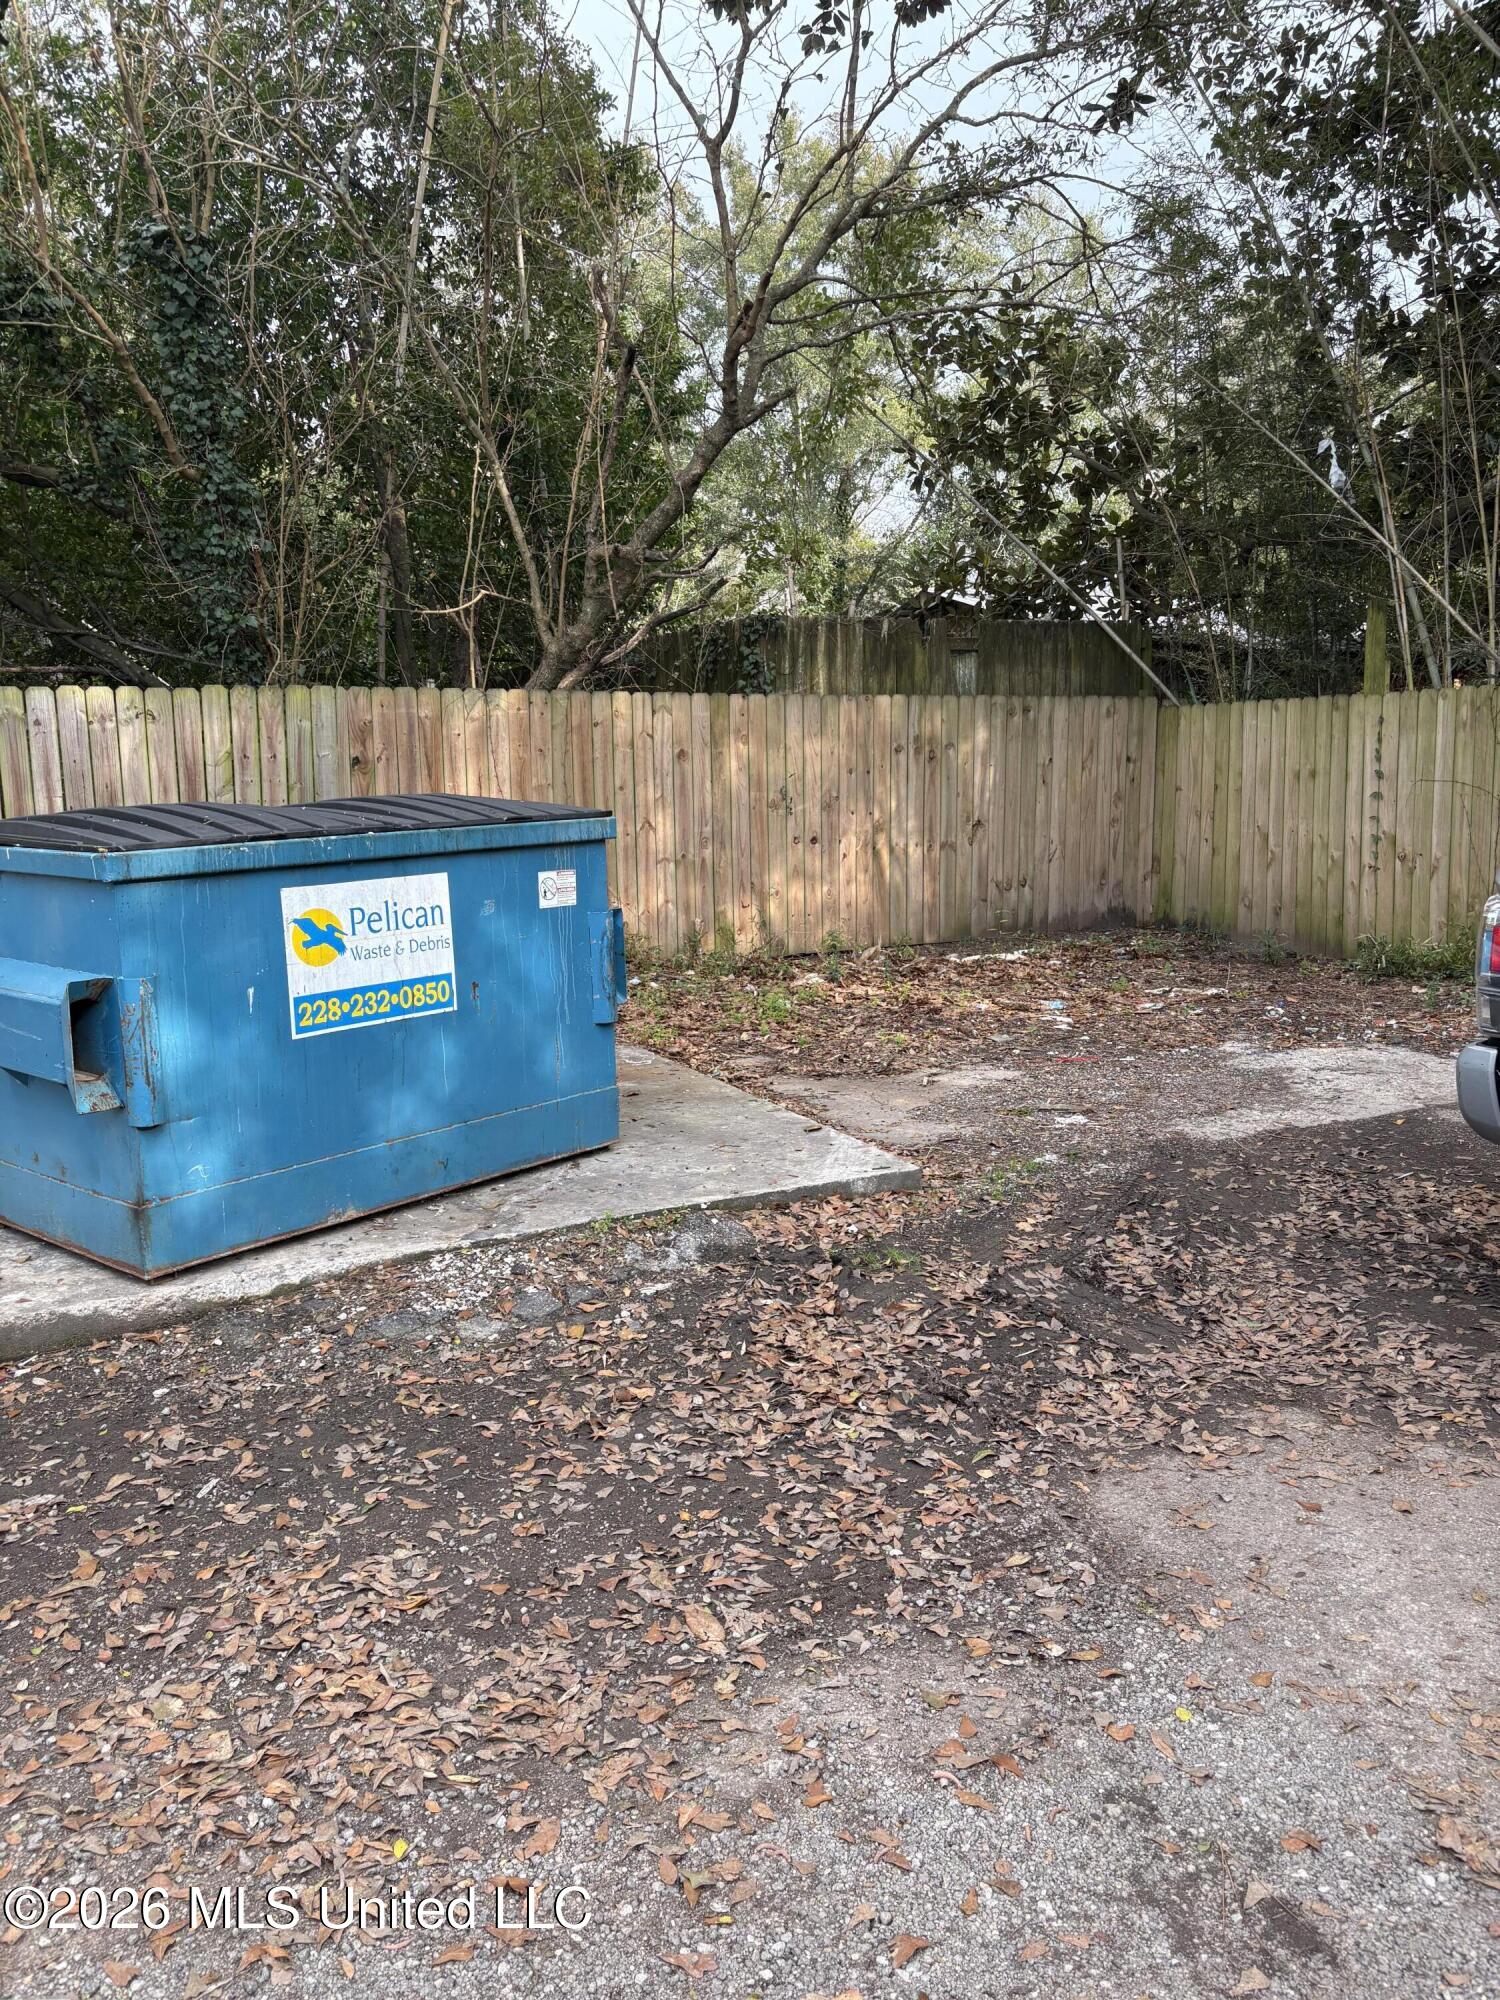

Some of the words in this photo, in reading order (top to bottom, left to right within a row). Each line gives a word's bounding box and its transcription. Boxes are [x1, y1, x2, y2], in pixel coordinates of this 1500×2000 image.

[349, 900, 445, 936] Pelican
[349, 945, 392, 961] Waste
[395, 940, 405, 955] &
[409, 935, 451, 954] Debris
